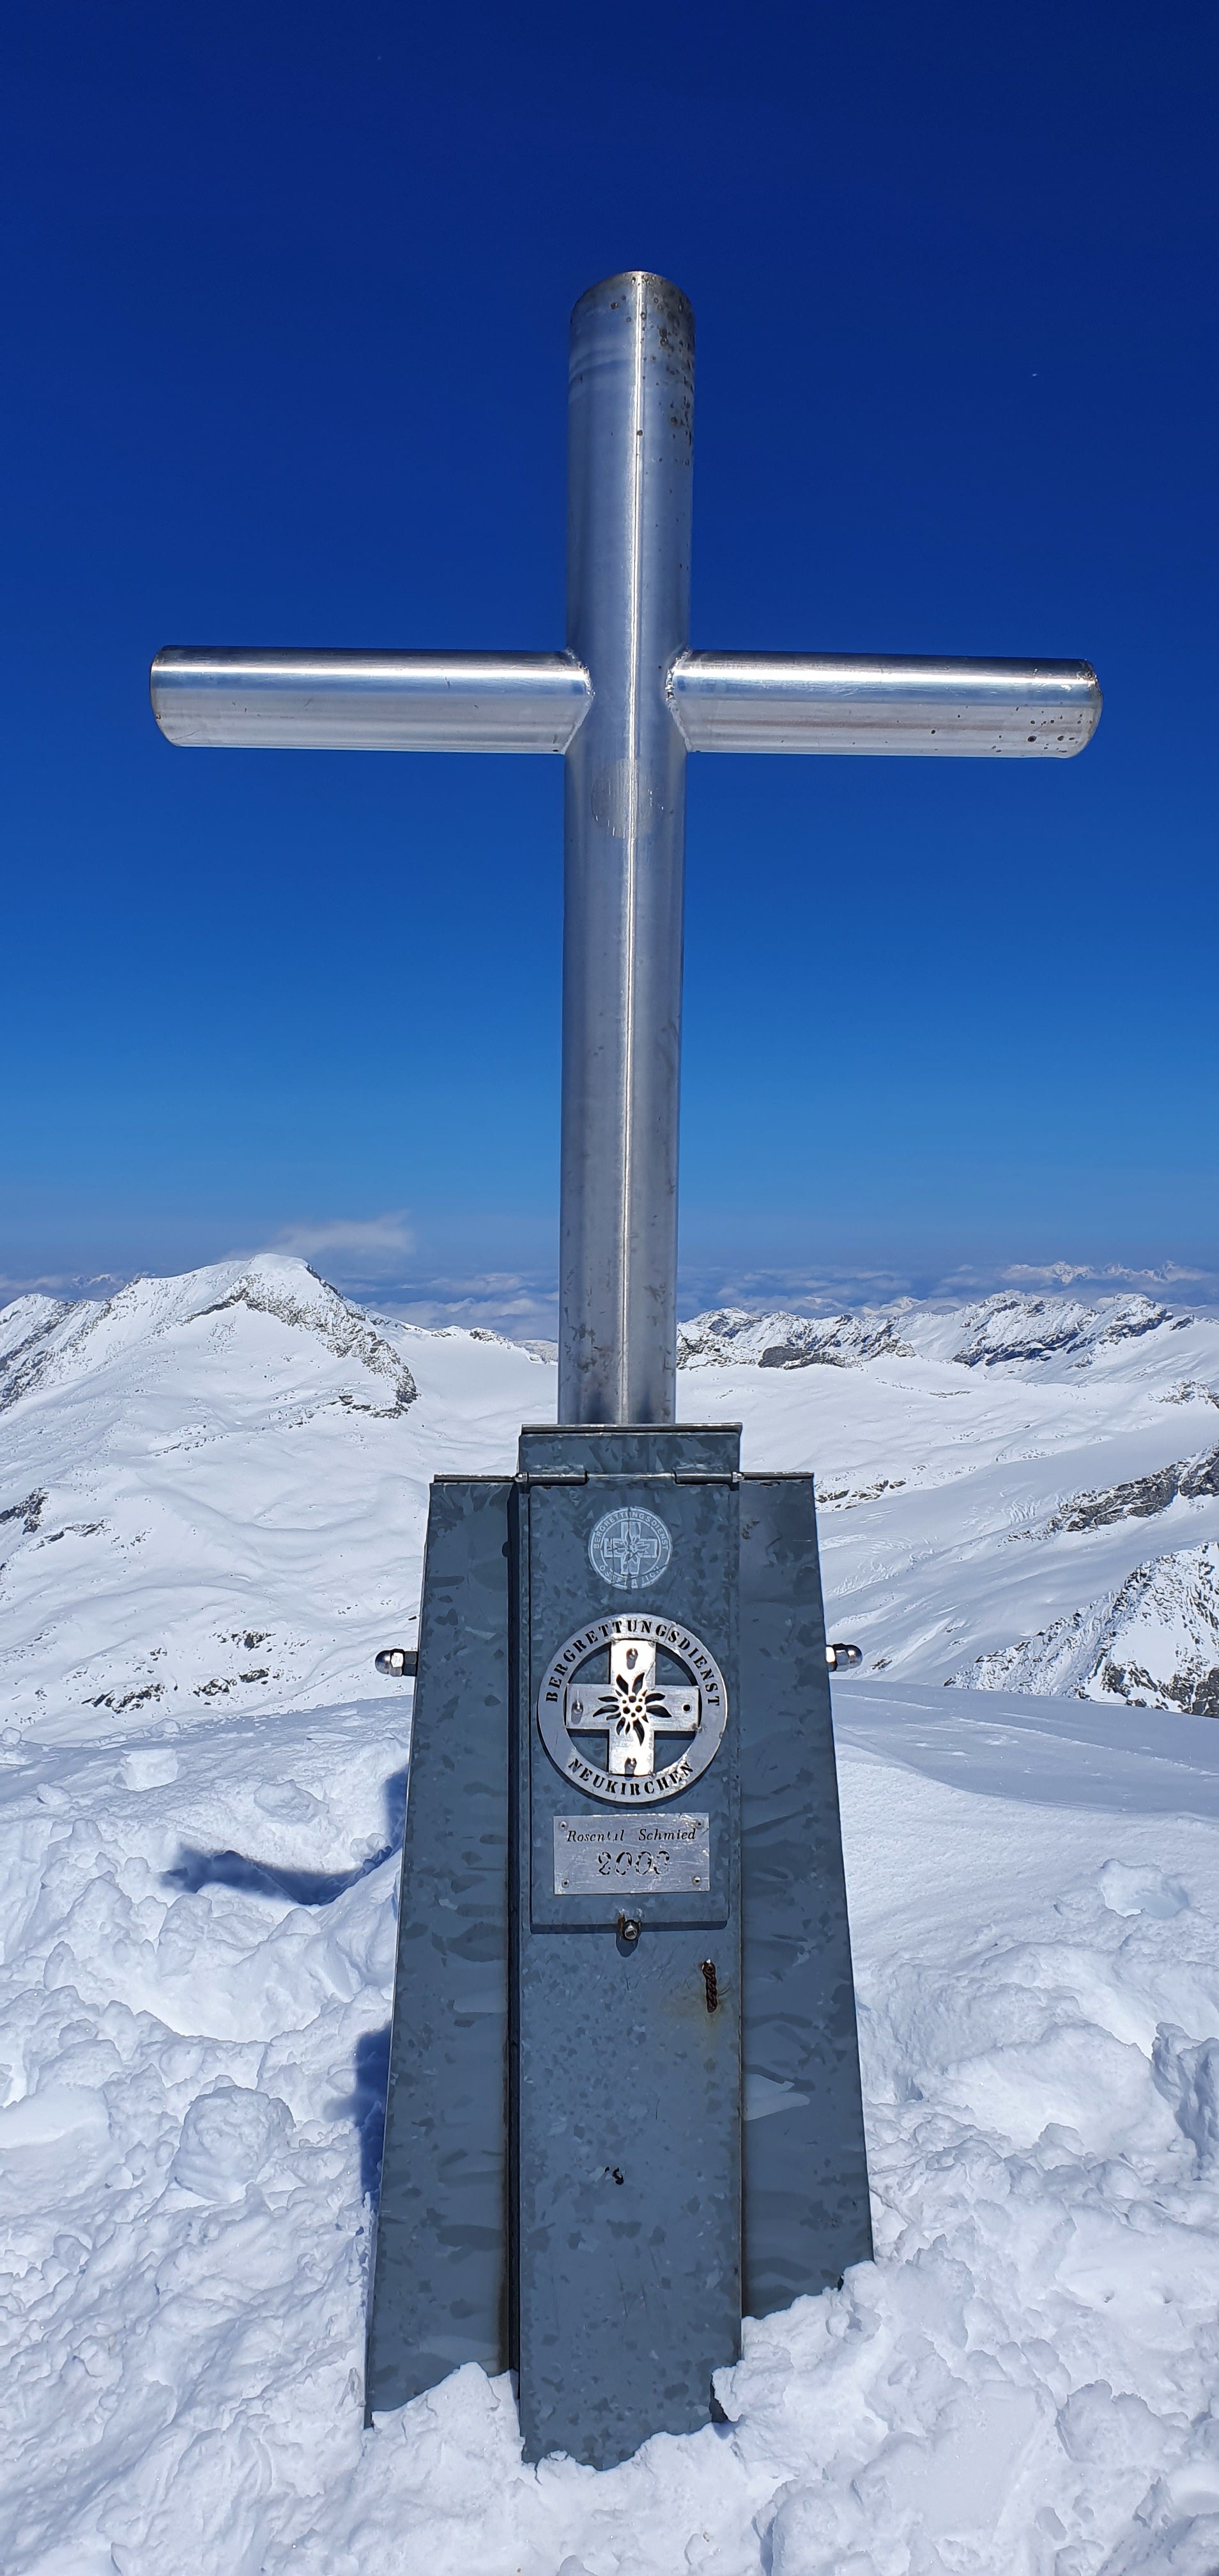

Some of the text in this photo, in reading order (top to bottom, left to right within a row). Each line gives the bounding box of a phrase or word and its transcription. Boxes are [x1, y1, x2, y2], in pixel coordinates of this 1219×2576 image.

[546, 1620, 720, 1706] BERGRETTUNGSDIENST
[568, 1758, 694, 1796] NEUKIRCHEN
[639, 1828, 696, 1841] Schmied
